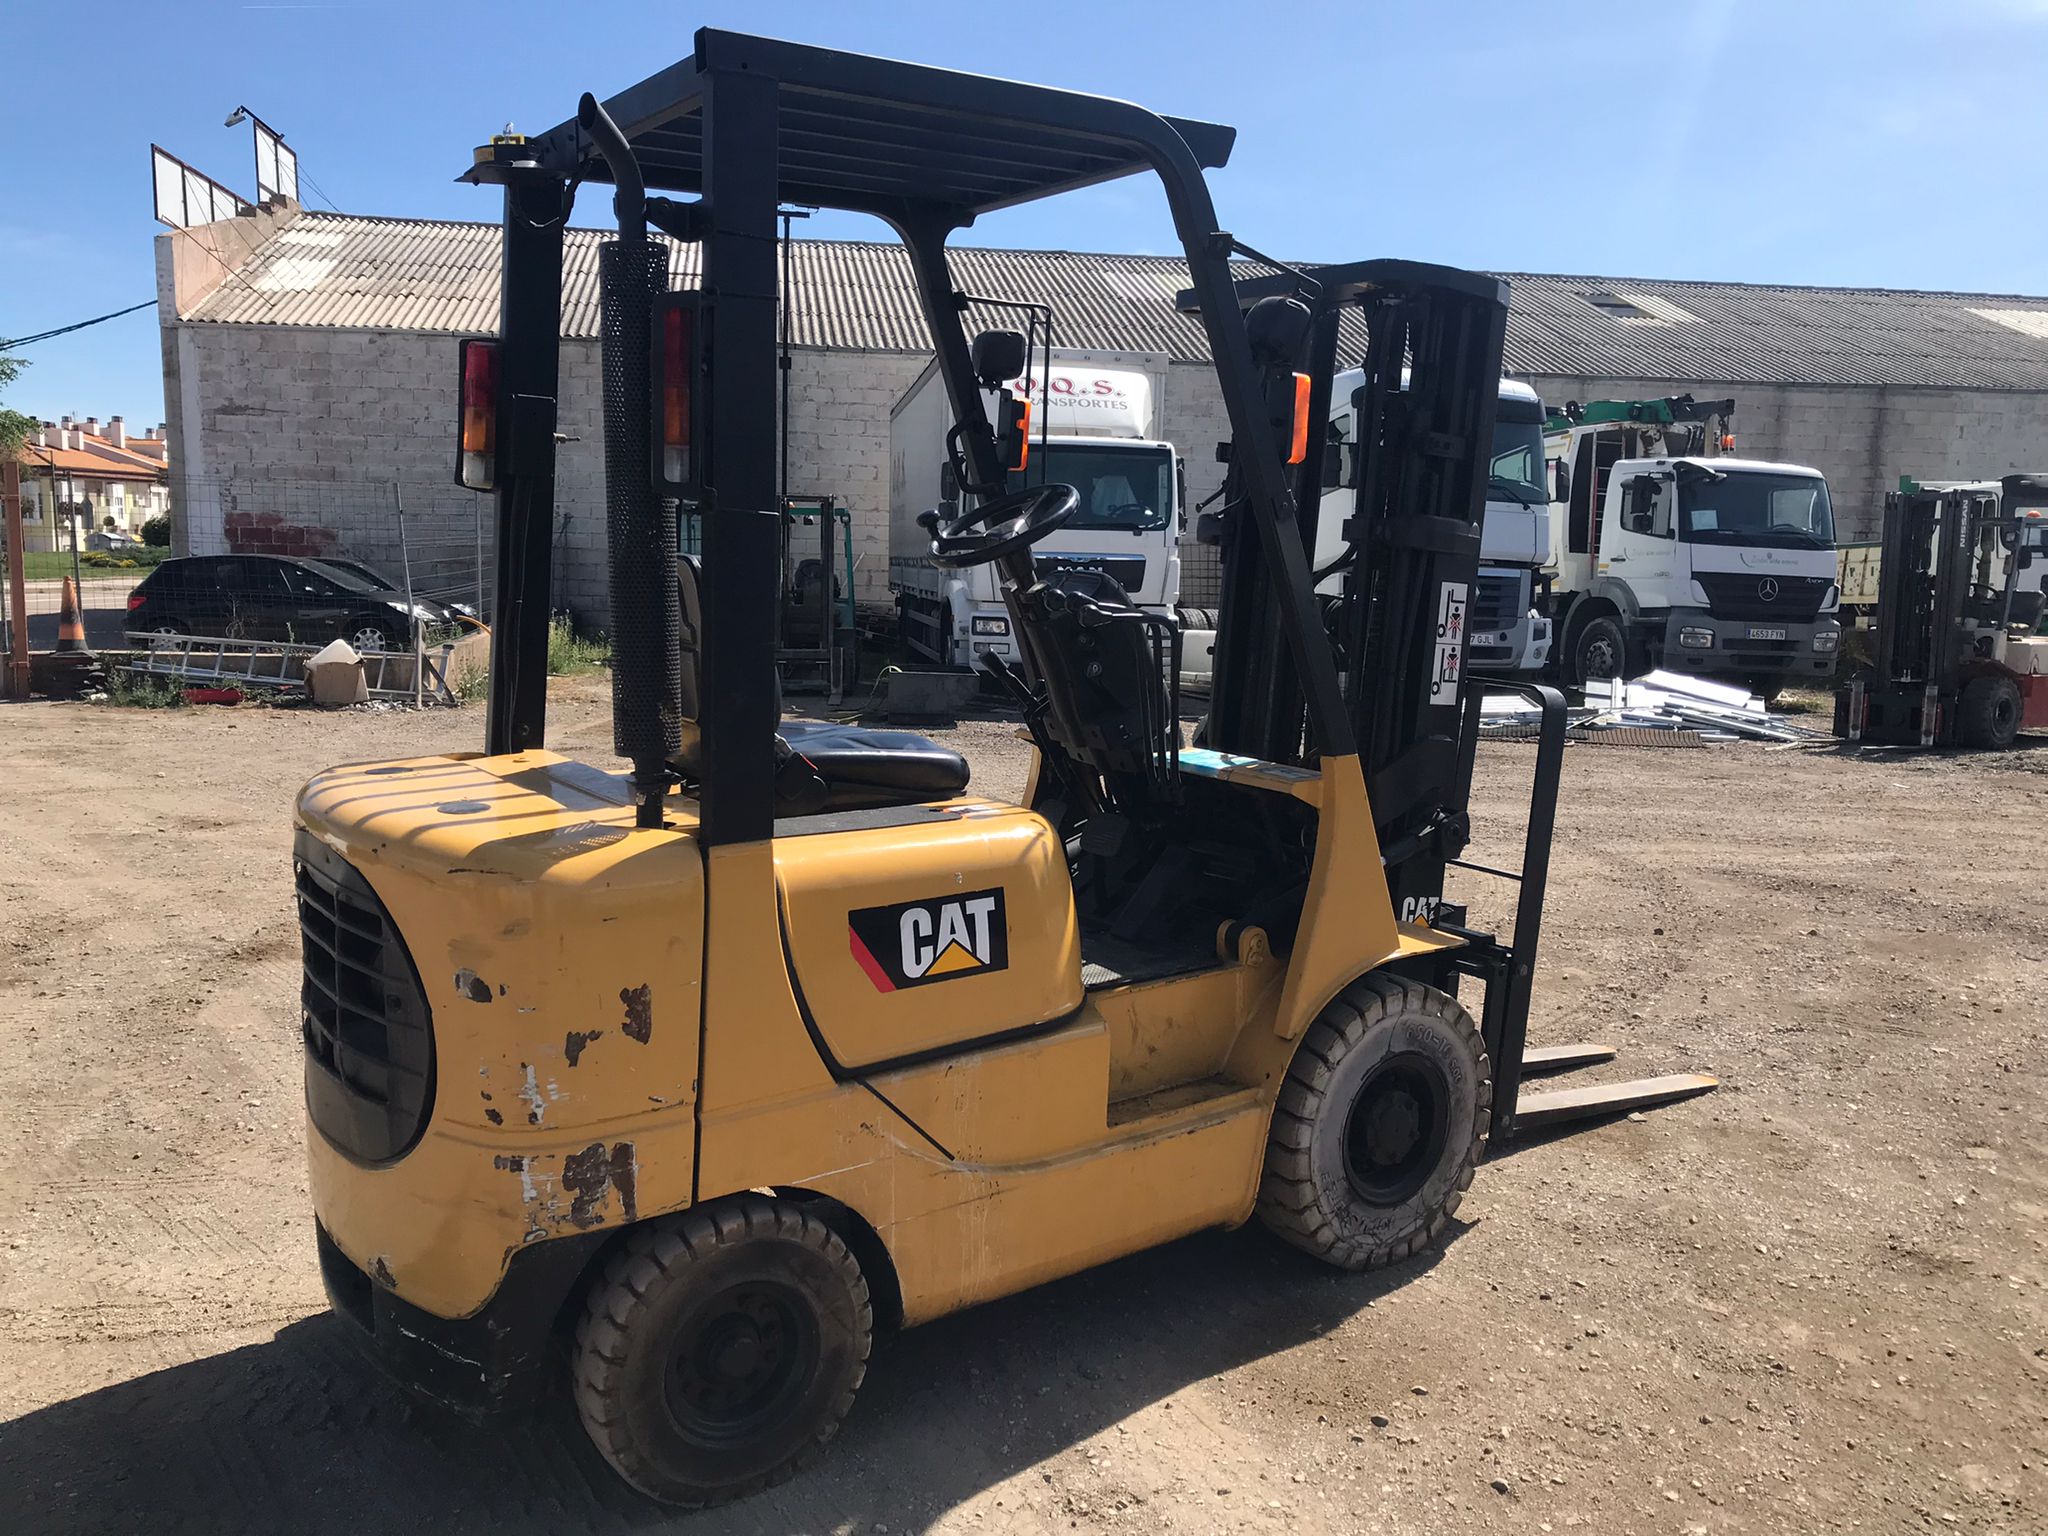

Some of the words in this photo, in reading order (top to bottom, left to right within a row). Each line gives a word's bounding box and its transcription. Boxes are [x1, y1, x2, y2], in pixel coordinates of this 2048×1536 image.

[1028, 396, 1129, 410] RANSPORTES
[1960, 499, 1969, 548] NISSAN
[1401, 896, 1440, 925] CAT
[900, 896, 996, 979] CAT
